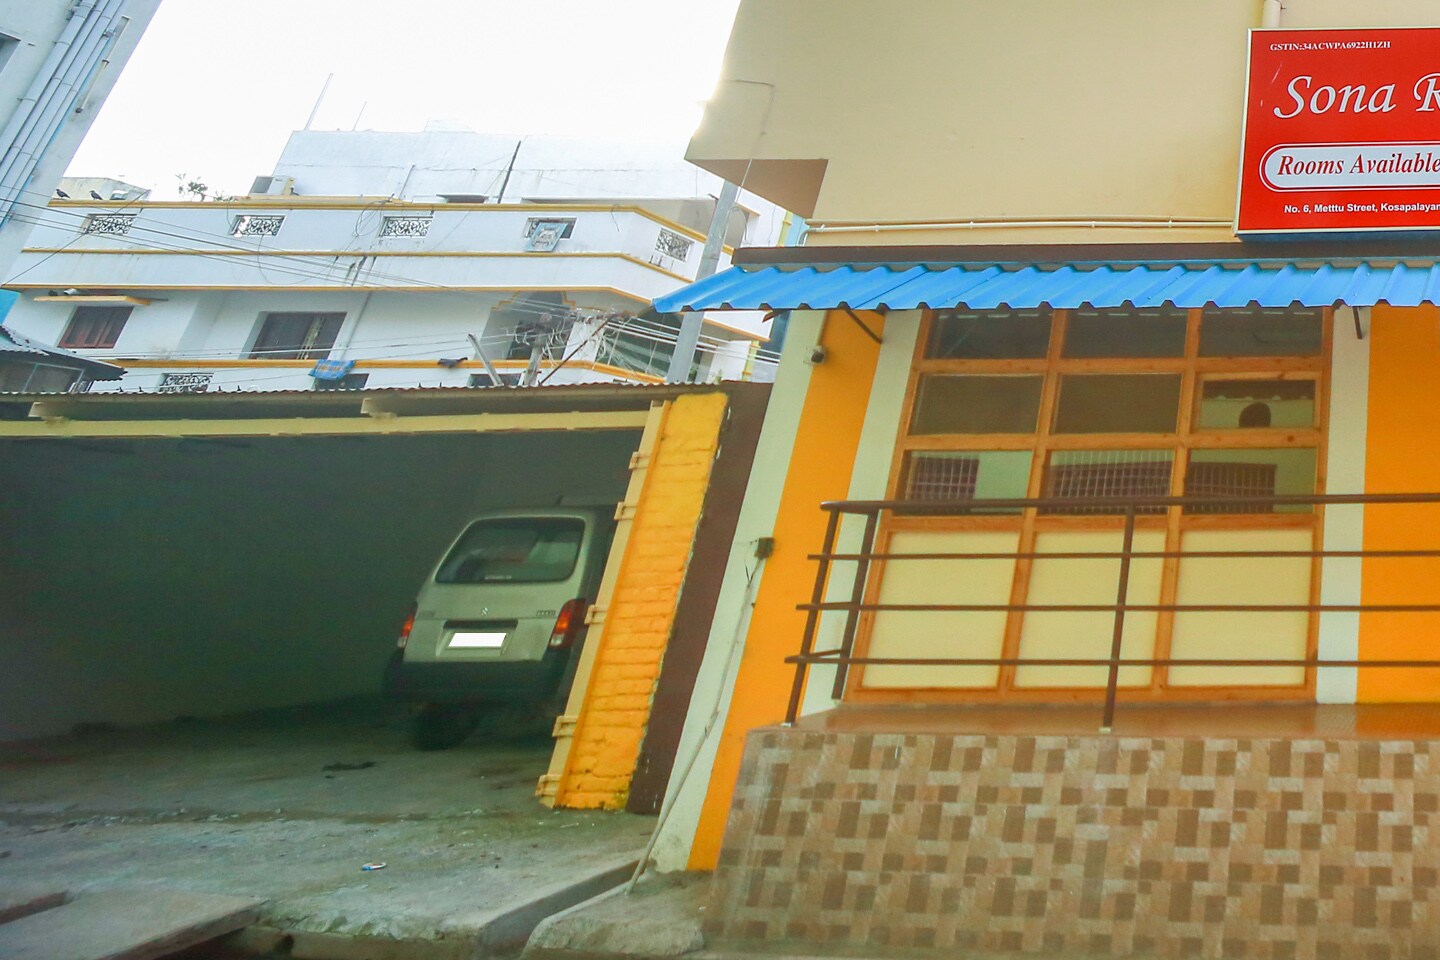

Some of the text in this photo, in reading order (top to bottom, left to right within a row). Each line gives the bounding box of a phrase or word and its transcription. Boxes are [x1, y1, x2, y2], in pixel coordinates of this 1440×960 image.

[1272, 75, 1397, 119] Sona
[1277, 155, 1345, 176] Rooms
[1284, 204, 1301, 213] No.
[1302, 204, 1312, 214] 6,
[1346, 203, 1378, 213] Street,
